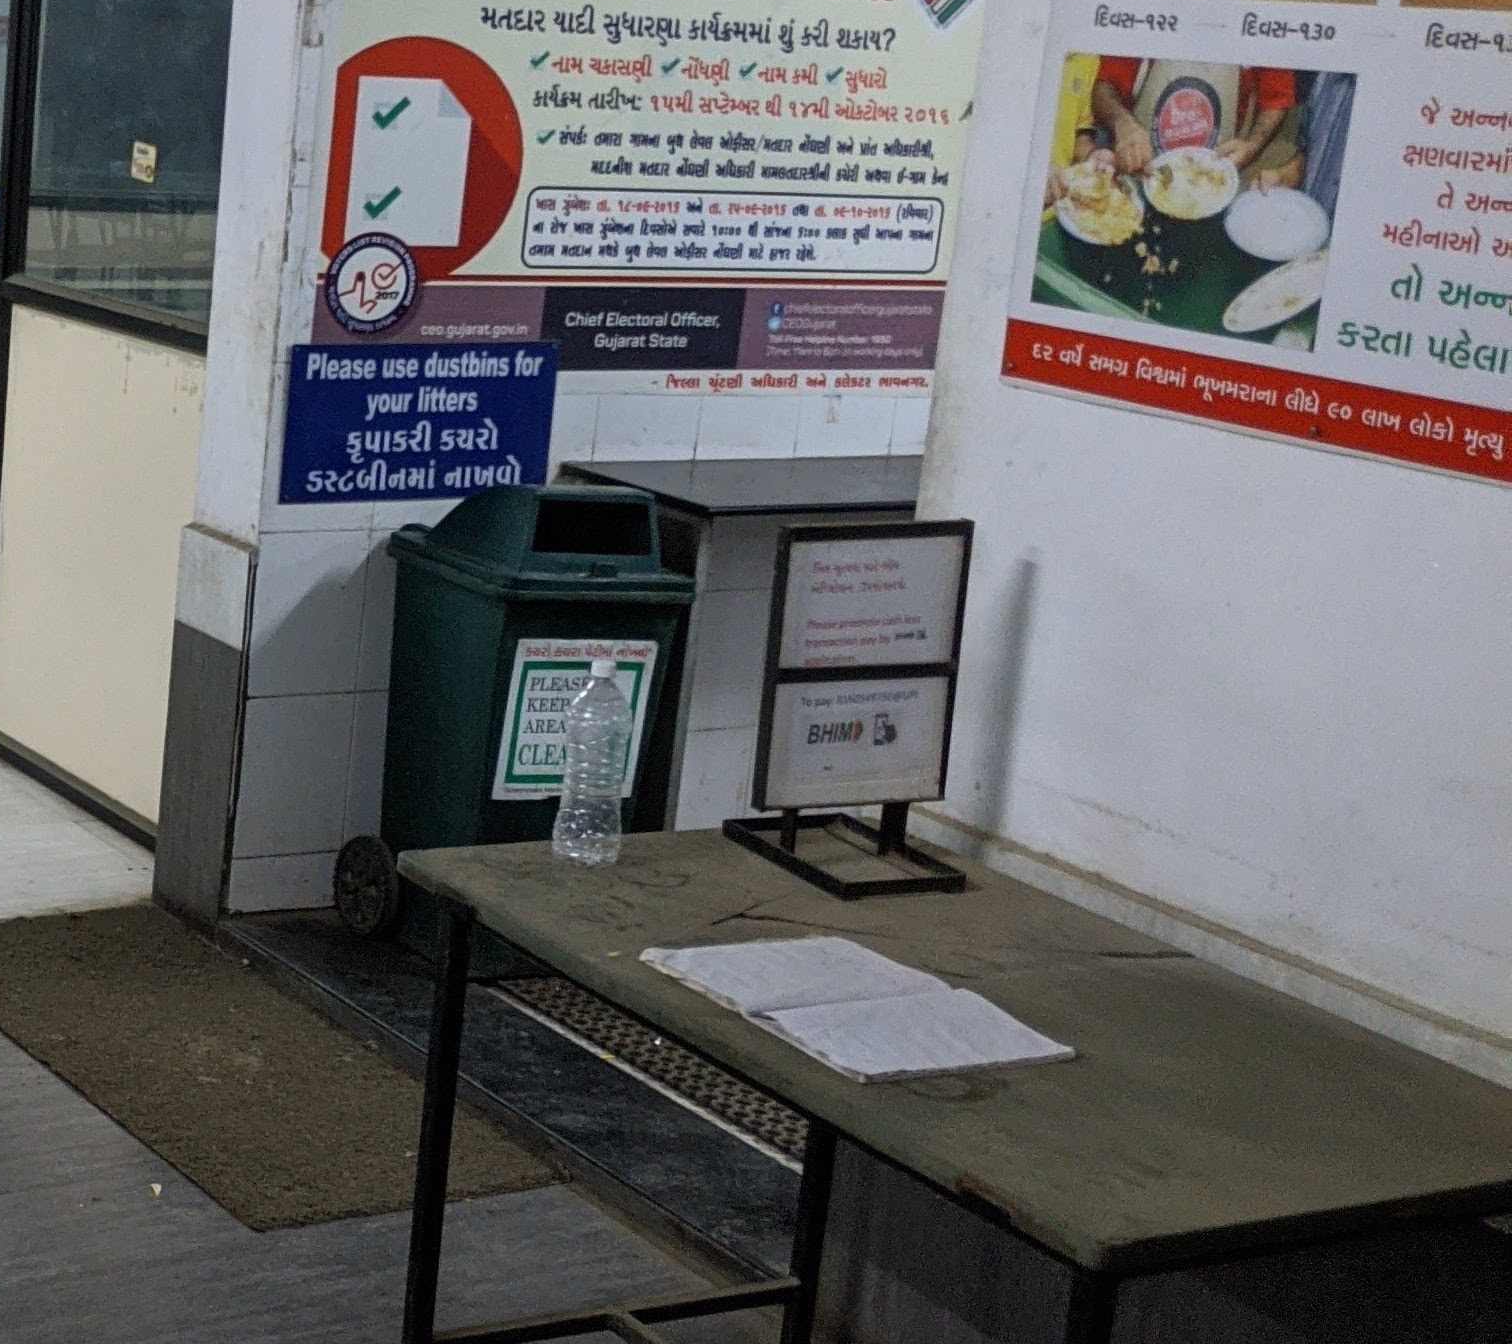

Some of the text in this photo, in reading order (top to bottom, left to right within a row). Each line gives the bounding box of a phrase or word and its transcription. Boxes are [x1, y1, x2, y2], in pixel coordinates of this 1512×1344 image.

[480, 6, 546, 33] મતદાર
[553, 4, 596, 35] યાદી
[603, 12, 681, 47] સુધારણા
[801, 18, 830, 48] કરી
[551, 56, 584, 75] નામ
[758, 67, 788, 84] નામ
[420, 323, 528, 339] ceo.gujarat.gov.in
[565, 311, 721, 330] Chief Electoral Officer,
[594, 333, 688, 353] Gujarat State
[1336, 318, 1412, 358] કરતા
[306, 350, 543, 381] Please use dustbins for
[364, 387, 478, 421] your litters
[1361, 407, 1400, 432] લાખ
[444, 455, 522, 488] નાખવો
[523, 720, 567, 733] AREA
[808, 721, 854, 744] BHIM
